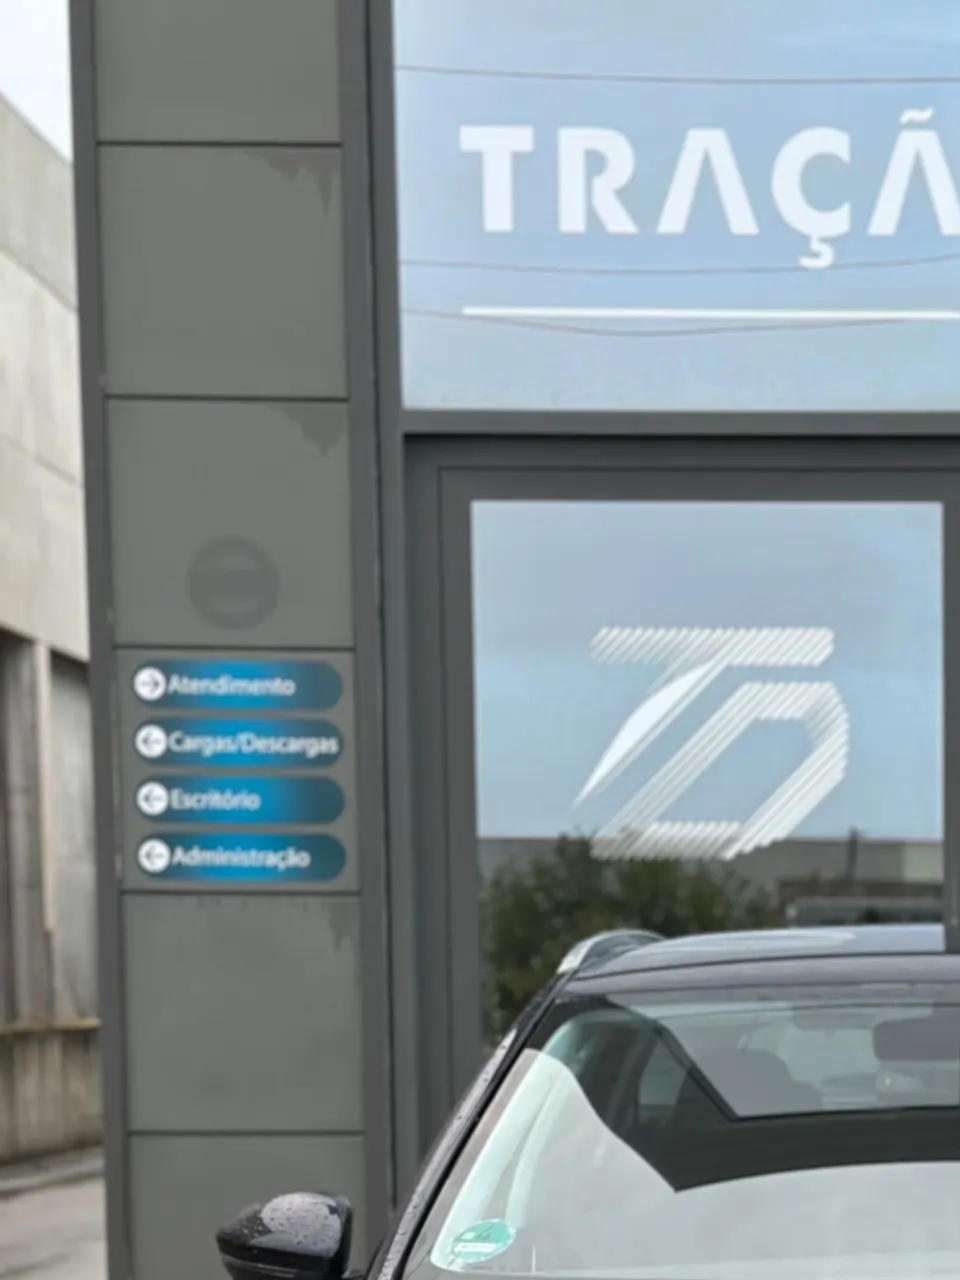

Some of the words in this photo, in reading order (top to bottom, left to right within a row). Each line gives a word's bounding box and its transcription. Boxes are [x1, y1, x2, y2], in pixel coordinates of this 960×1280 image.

[167, 674, 297, 696] Atendimento
[168, 730, 339, 757] Cargas/Descargas
[169, 787, 262, 811] Escritório
[171, 846, 311, 872] Administração
